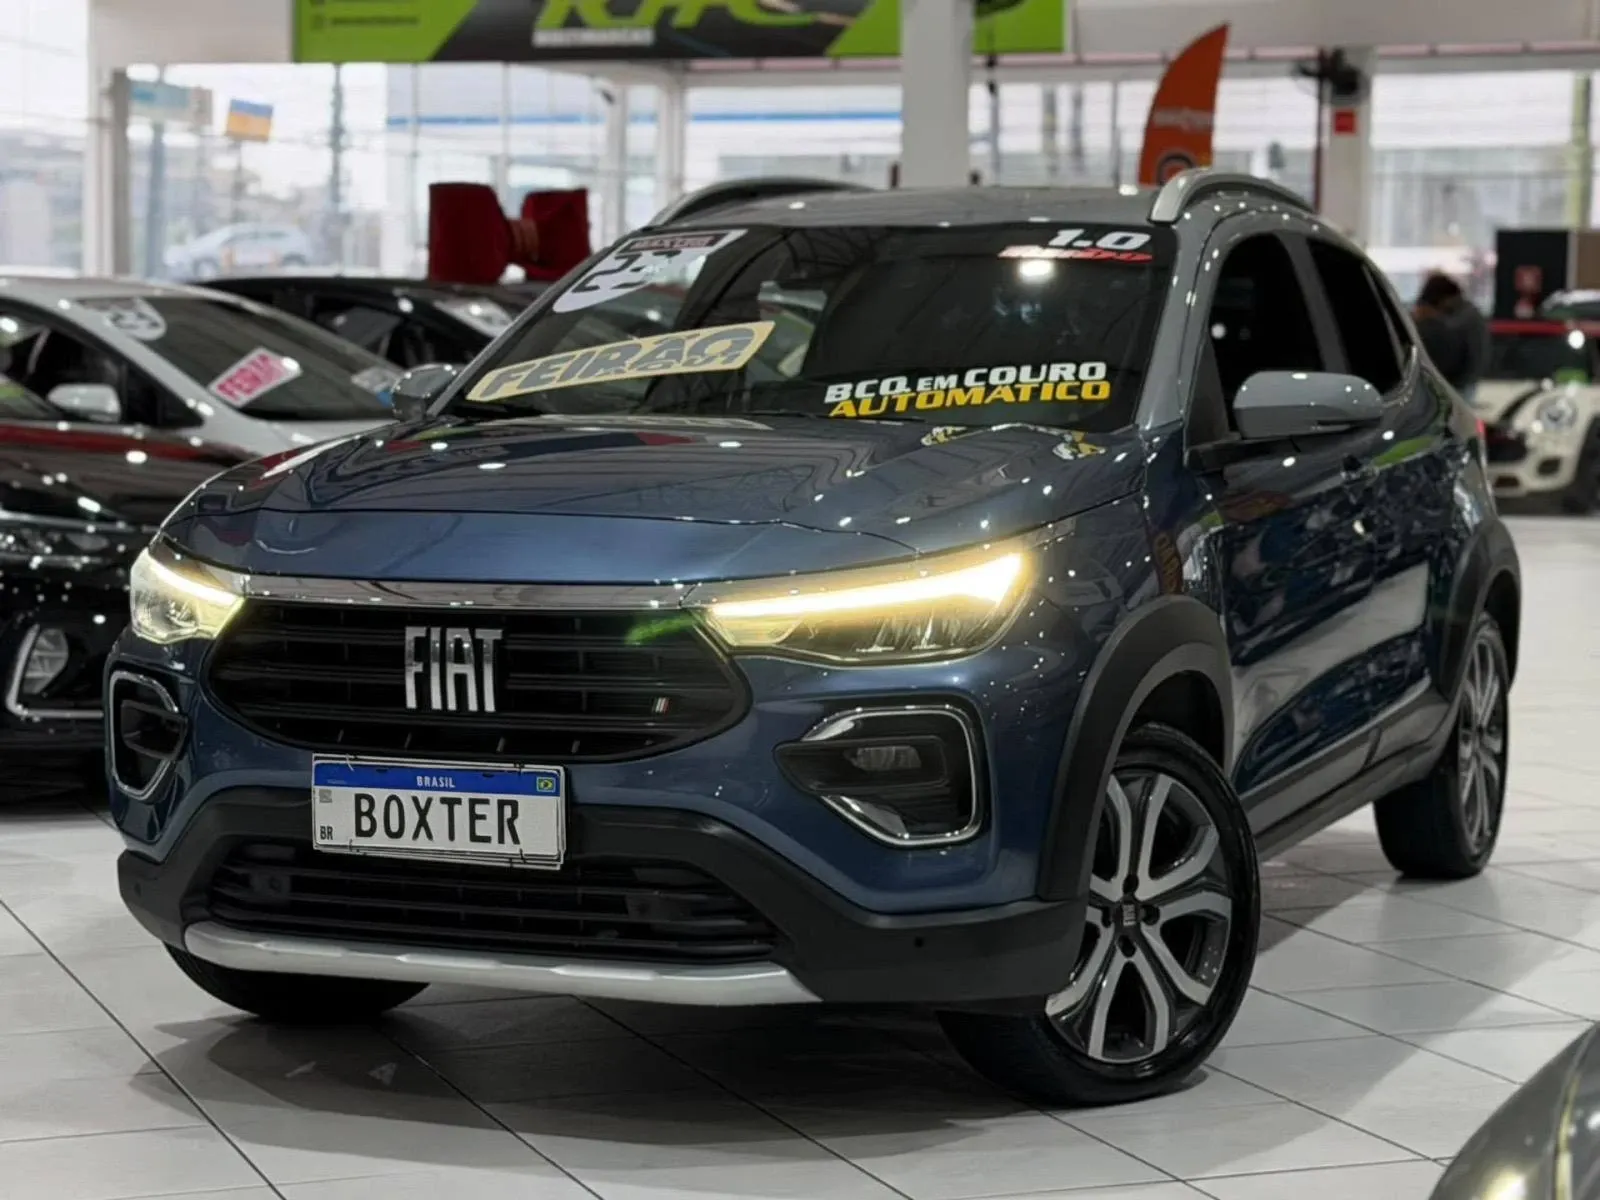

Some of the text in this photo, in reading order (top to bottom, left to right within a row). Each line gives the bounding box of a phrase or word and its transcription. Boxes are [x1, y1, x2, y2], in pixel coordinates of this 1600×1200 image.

[1048, 229, 1151, 250] 1.0
[916, 374, 958, 391] EM
[964, 361, 1107, 387] COURO
[404, 625, 503, 712] FIAT
[415, 775, 456, 788] BRASIL
[353, 792, 521, 846] BOXTER
[319, 825, 334, 841] BR
